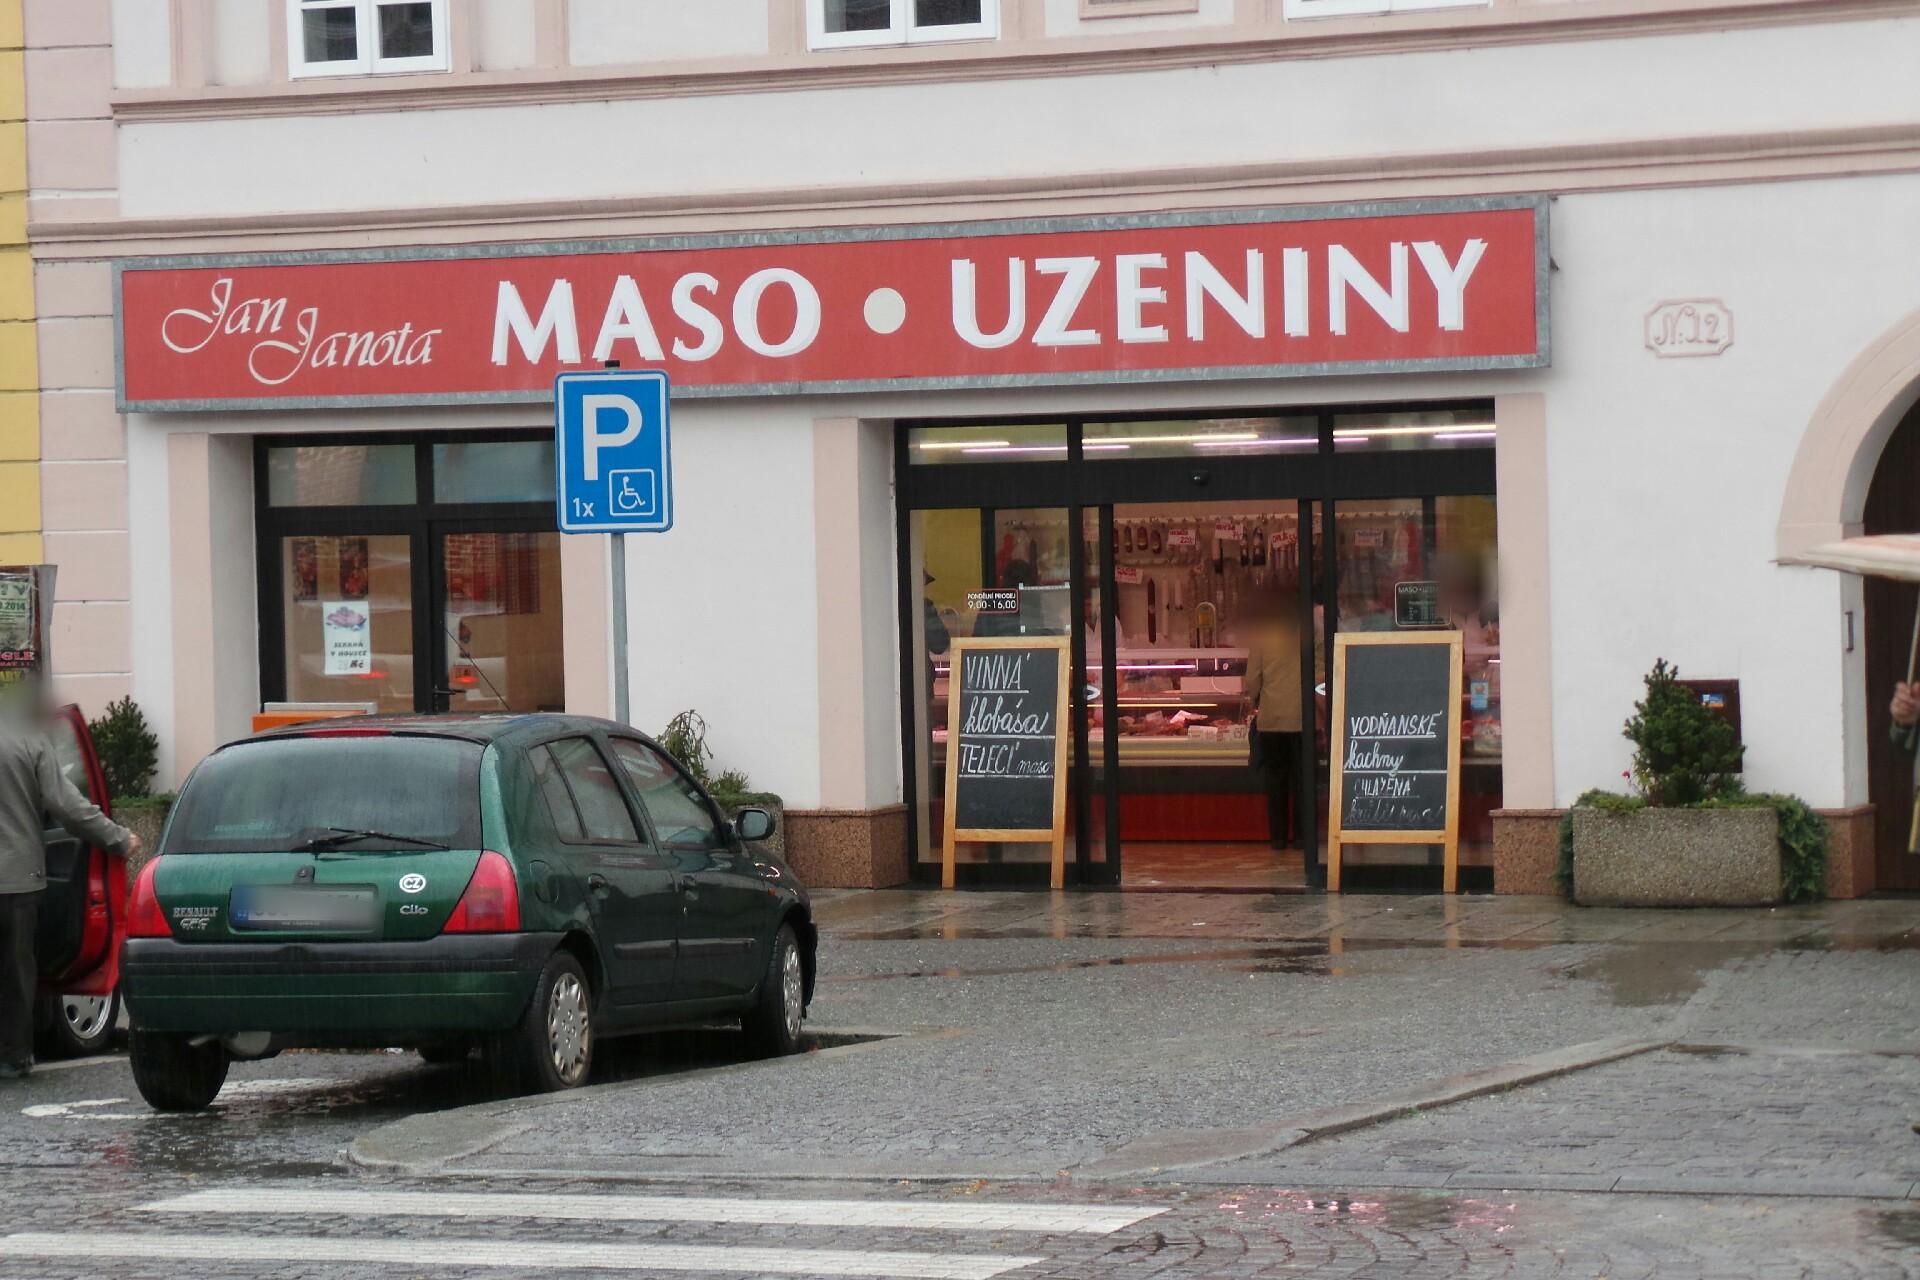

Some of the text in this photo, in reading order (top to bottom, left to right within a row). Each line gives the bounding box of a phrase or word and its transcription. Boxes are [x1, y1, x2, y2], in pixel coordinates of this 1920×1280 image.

[162, 278, 287, 353] Jan
[492, 238, 1488, 367] MASO UZENINY
[249, 307, 442, 385] Janota
[582, 394, 643, 481] P
[573, 497, 595, 518] 1x
[966, 652, 1031, 690] VINNÁ
[959, 741, 1020, 774] TELECÍ
[404, 877, 421, 889] CZ
[173, 907, 219, 917] RENAULT
[400, 904, 428, 915] Clio
